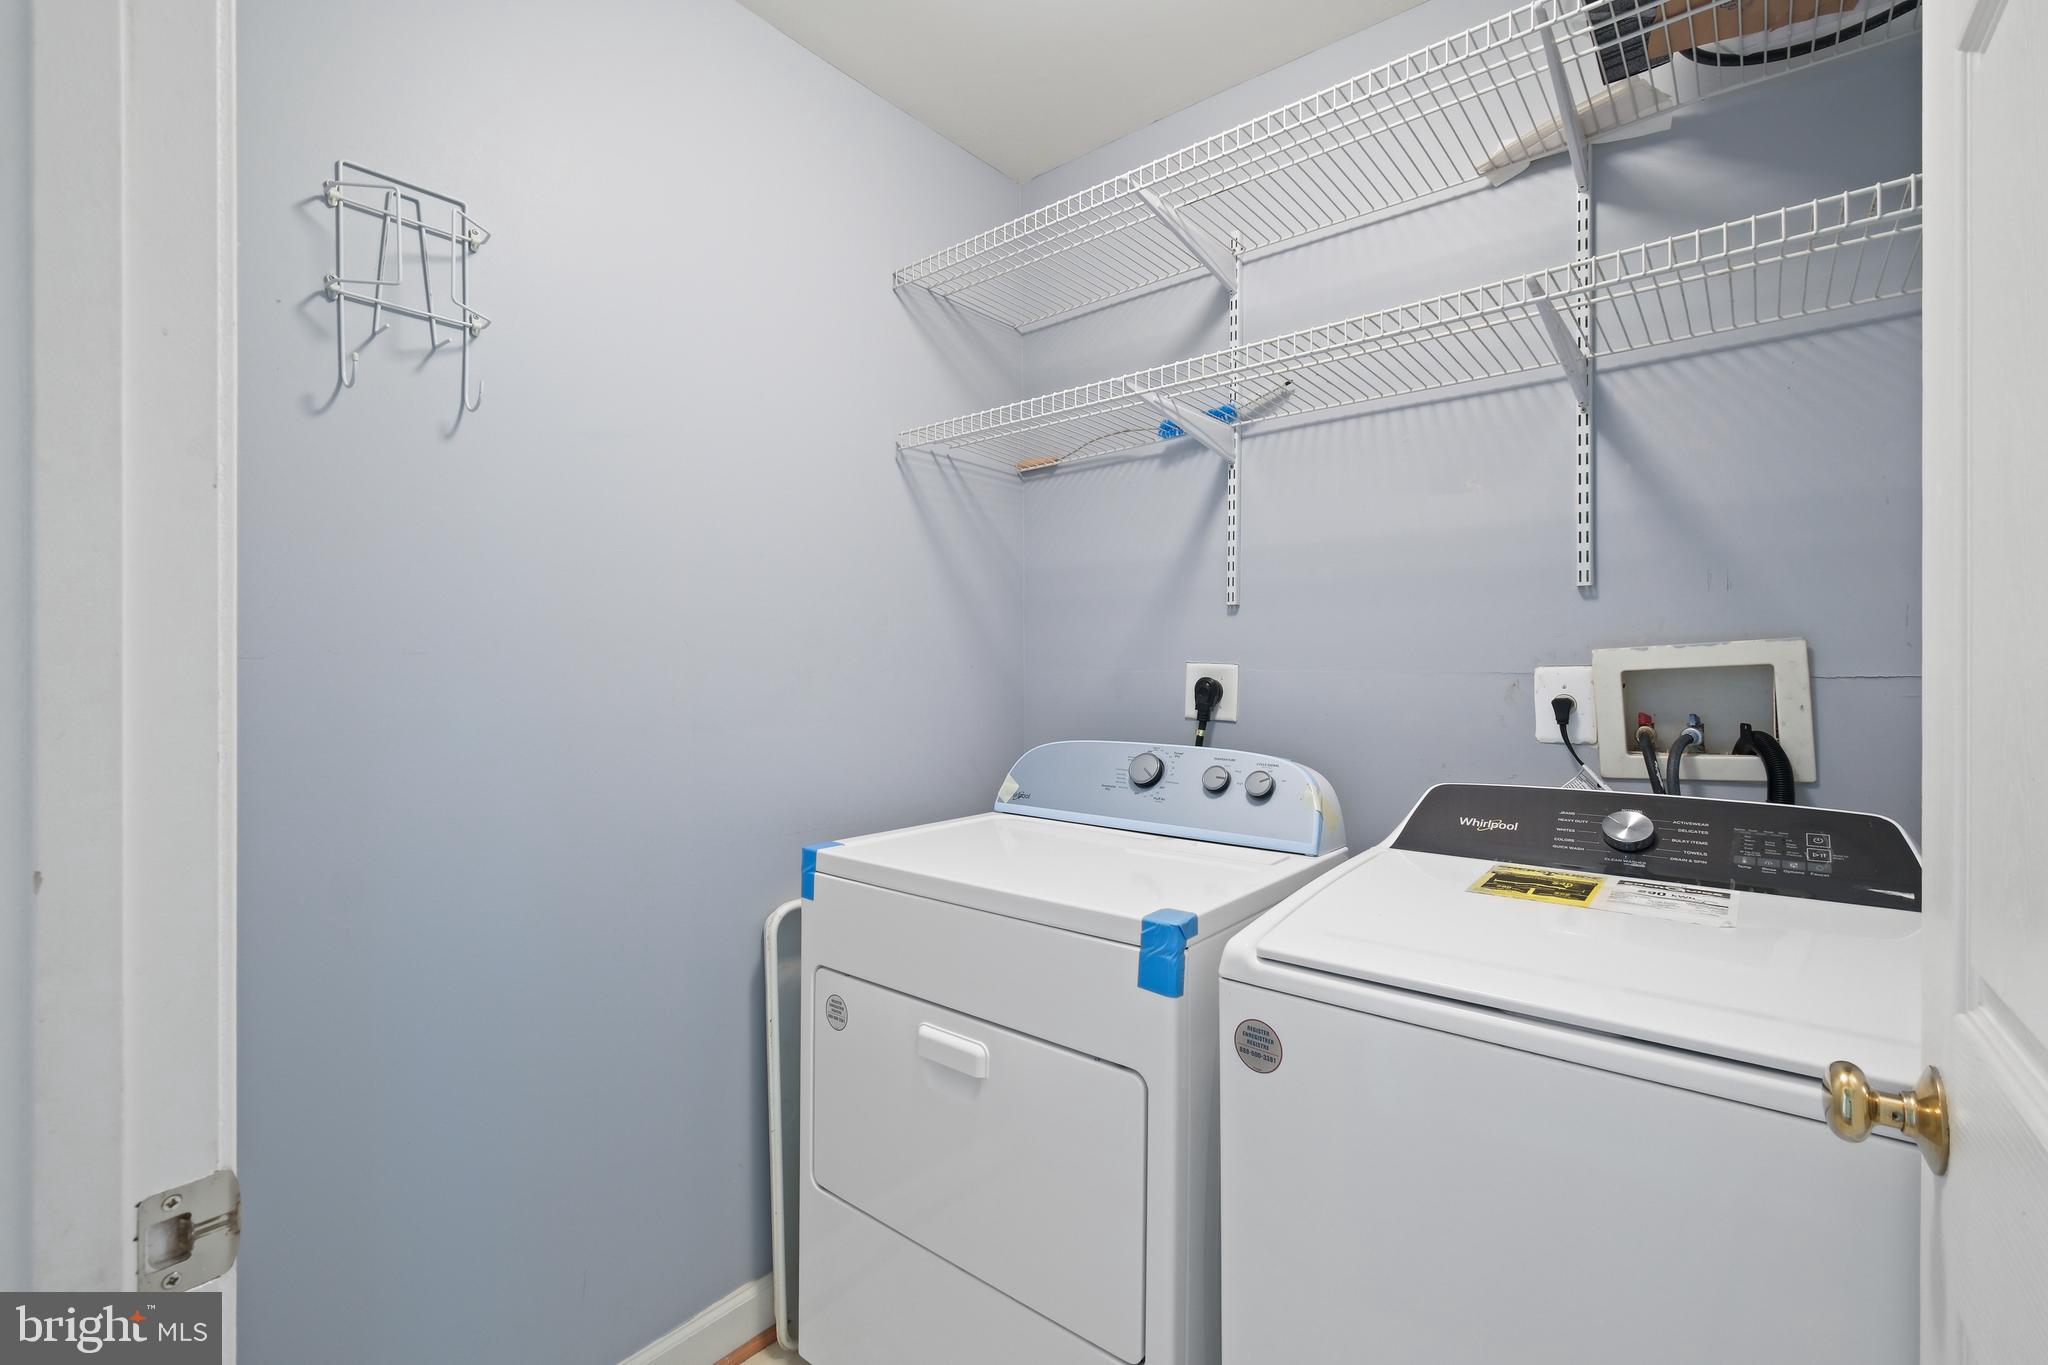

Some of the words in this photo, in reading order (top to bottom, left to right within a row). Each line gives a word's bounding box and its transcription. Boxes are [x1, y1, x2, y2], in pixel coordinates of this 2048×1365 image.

[1459, 816, 1519, 832] Whirlpool
[1242, 1030, 1275, 1045] ENREGISTRER
[1246, 1025, 1270, 1036] REGISTER
